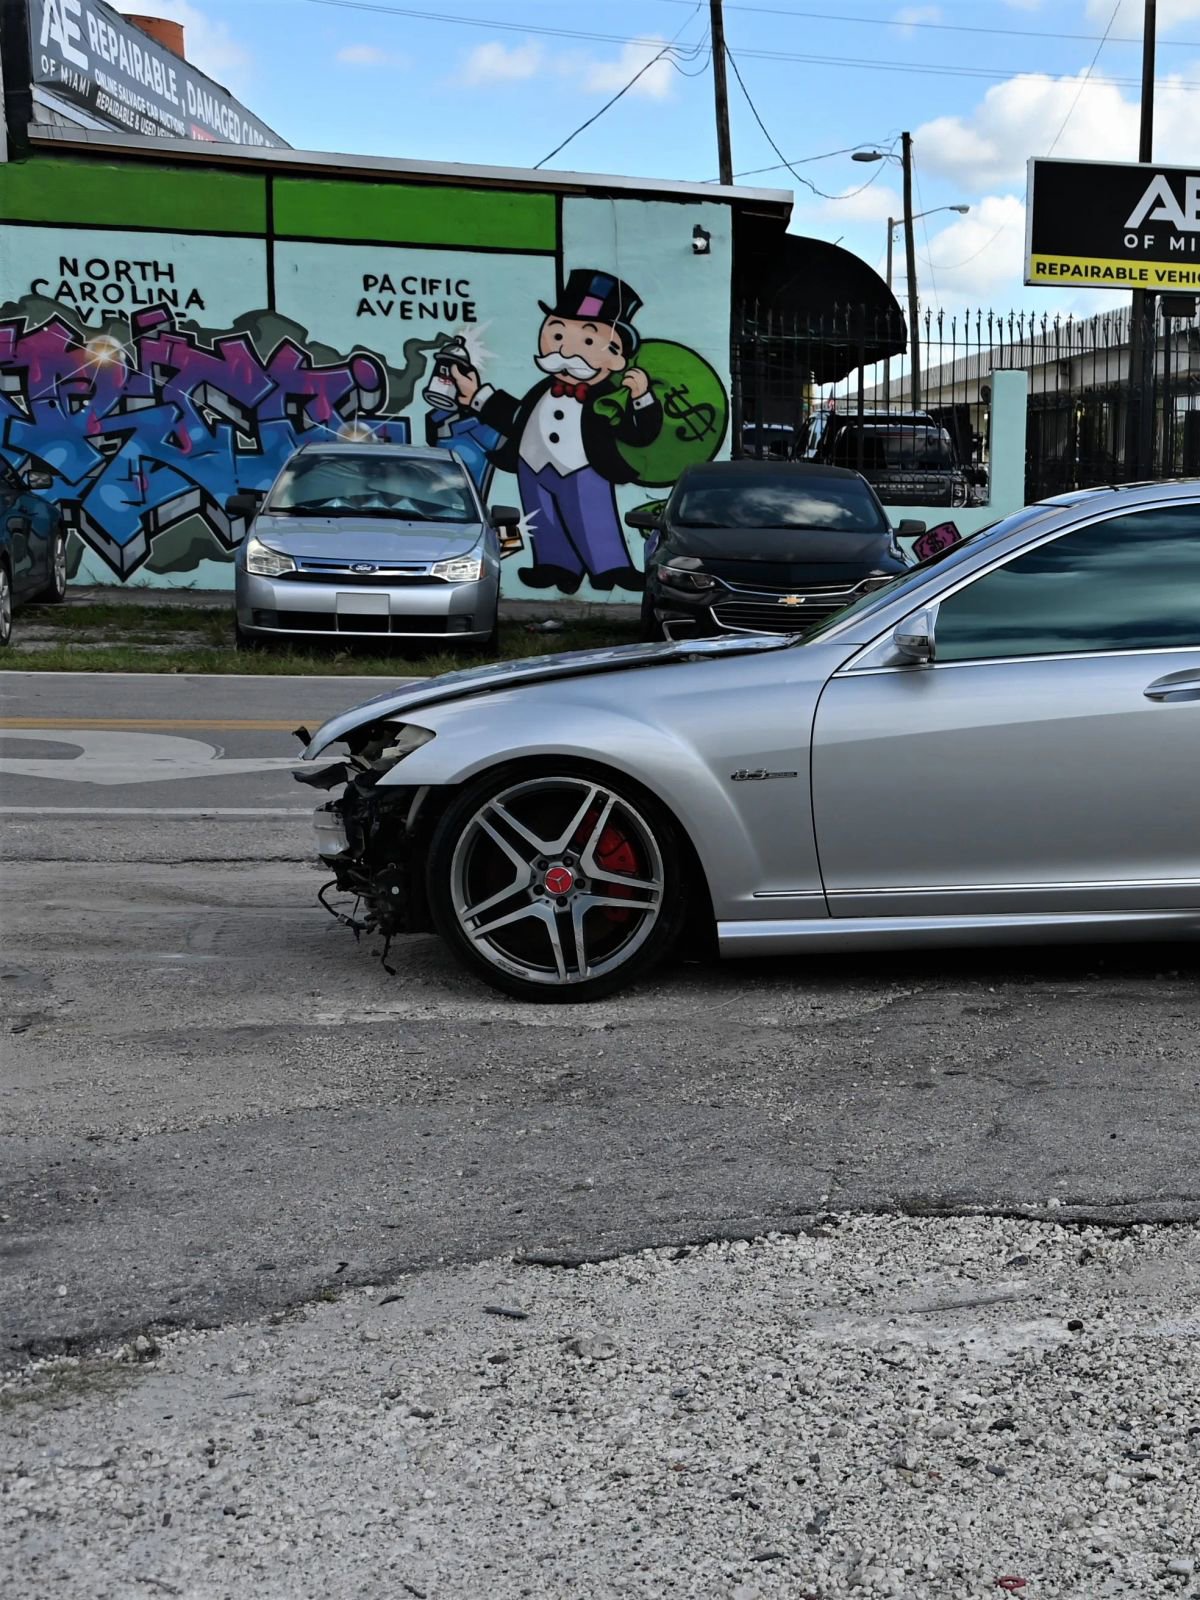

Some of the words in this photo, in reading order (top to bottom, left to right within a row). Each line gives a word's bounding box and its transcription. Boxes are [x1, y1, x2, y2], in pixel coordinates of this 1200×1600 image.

[41, 55, 56, 77] OF
[61, 65, 90, 97] MIAMI
[187, 80, 241, 144] DAMAGED
[1124, 233, 1155, 249] OF
[59, 256, 175, 284] NORTH
[1035, 261, 1149, 281] REPAIRABLE
[30, 278, 205, 310] CAROLINA
[362, 274, 470, 298] PACIFIC
[356, 297, 478, 323] AVENUE
